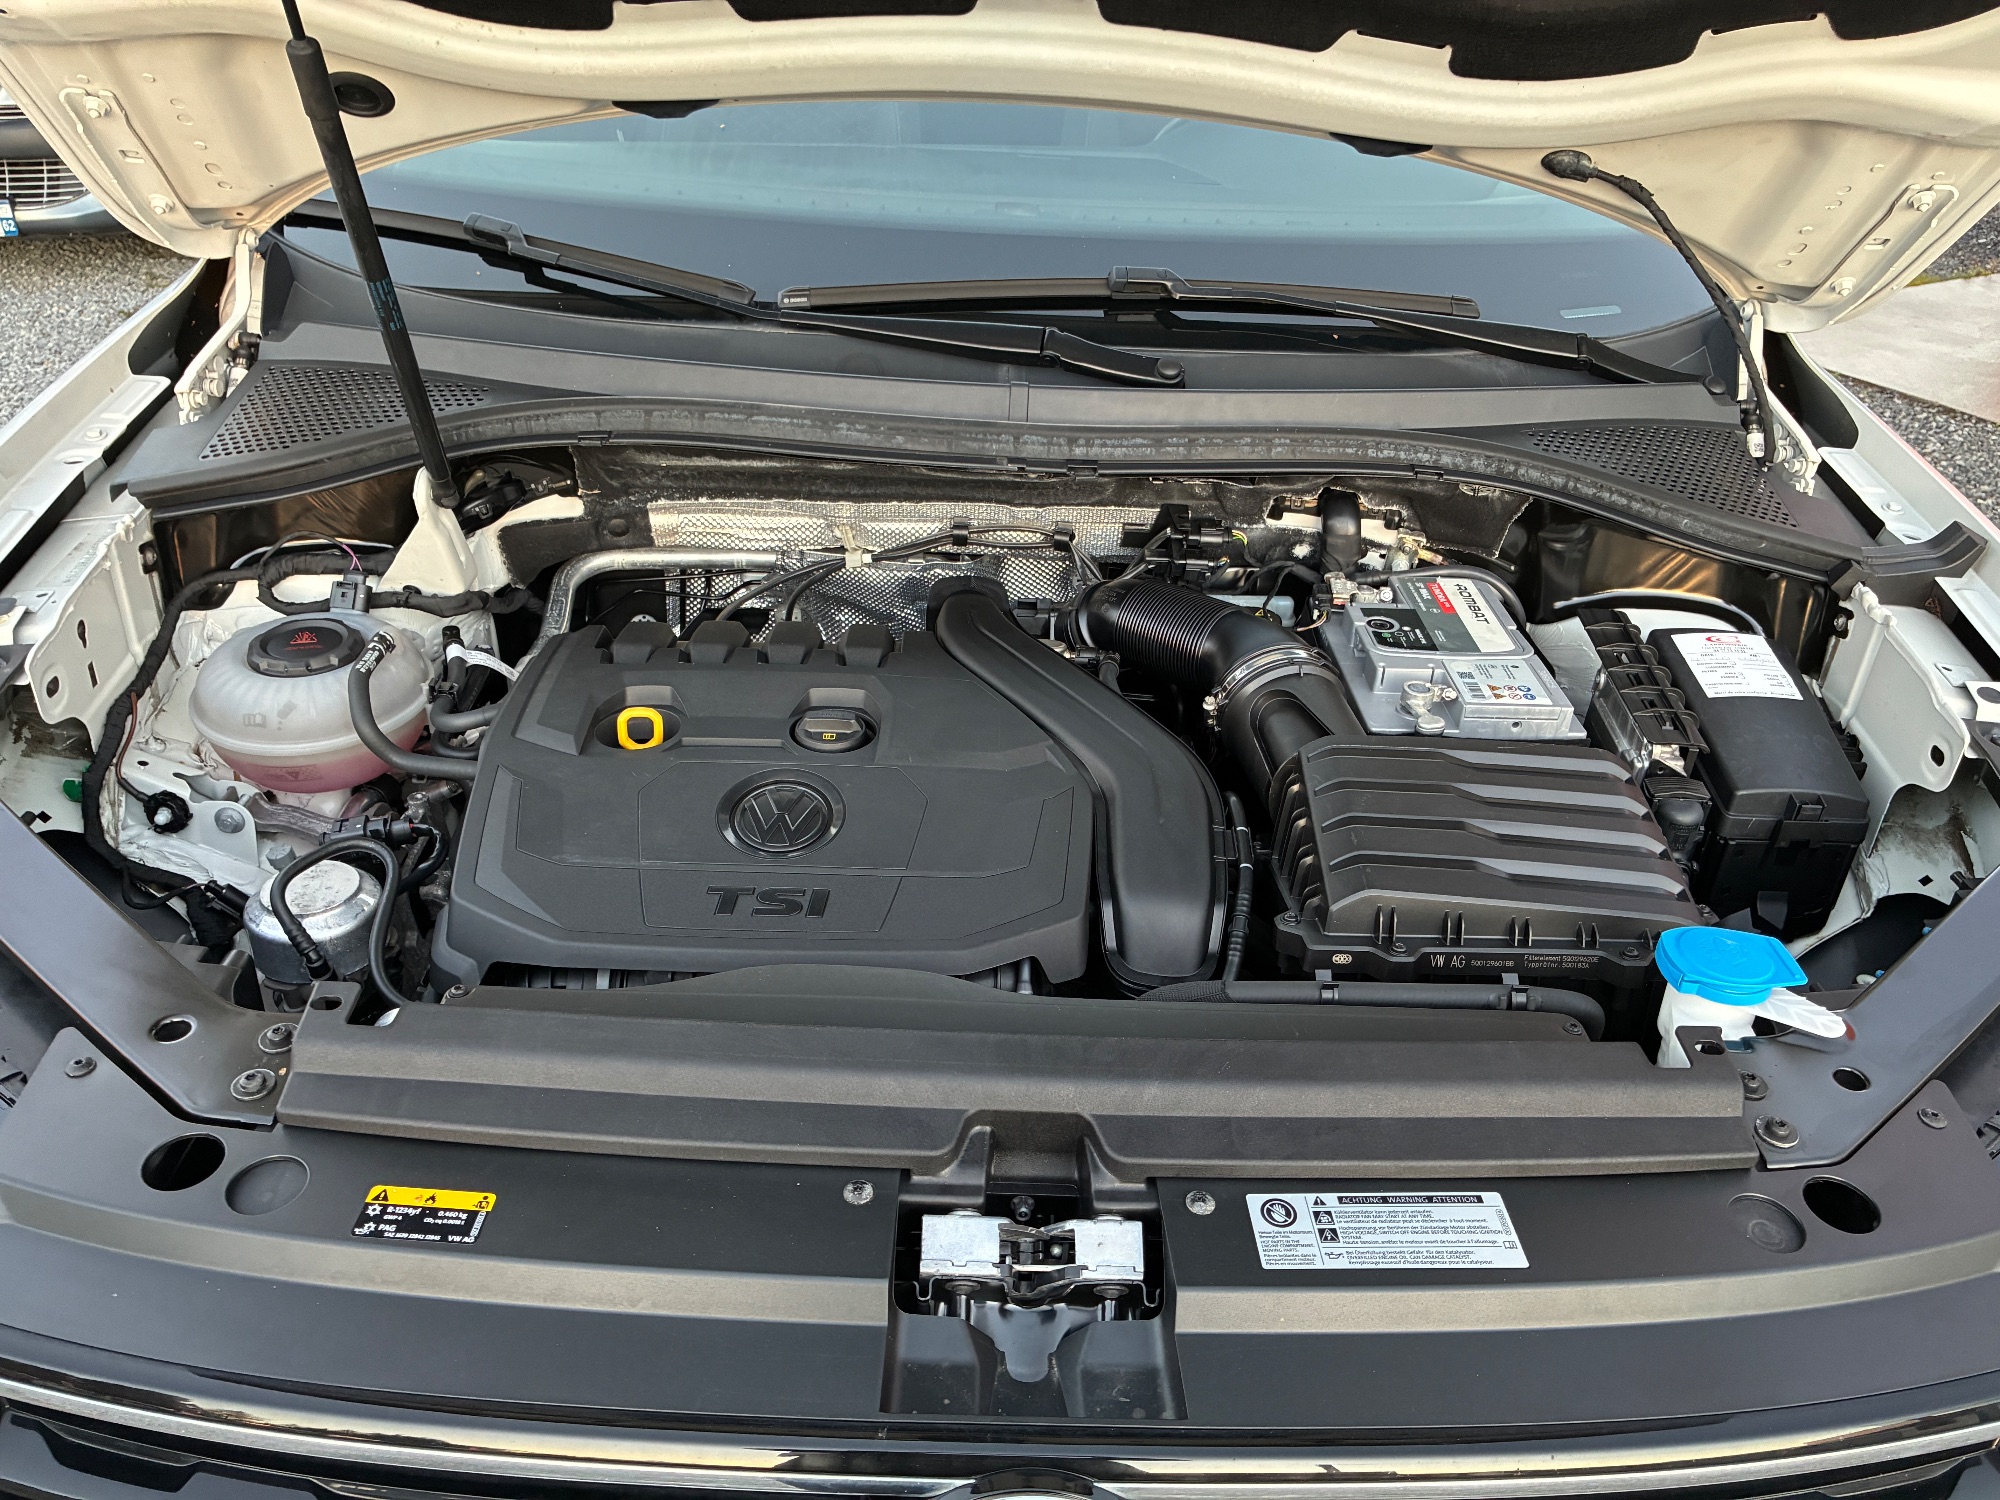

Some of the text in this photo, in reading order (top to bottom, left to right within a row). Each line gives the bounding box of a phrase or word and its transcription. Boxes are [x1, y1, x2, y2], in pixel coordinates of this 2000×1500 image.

[1430, 583, 1446, 602] TUNDRA
[1454, 583, 1492, 625] ROMBAT
[706, 884, 831, 918] TSI
[1430, 954, 1446, 968] VW
[1450, 954, 1466, 968] AG
